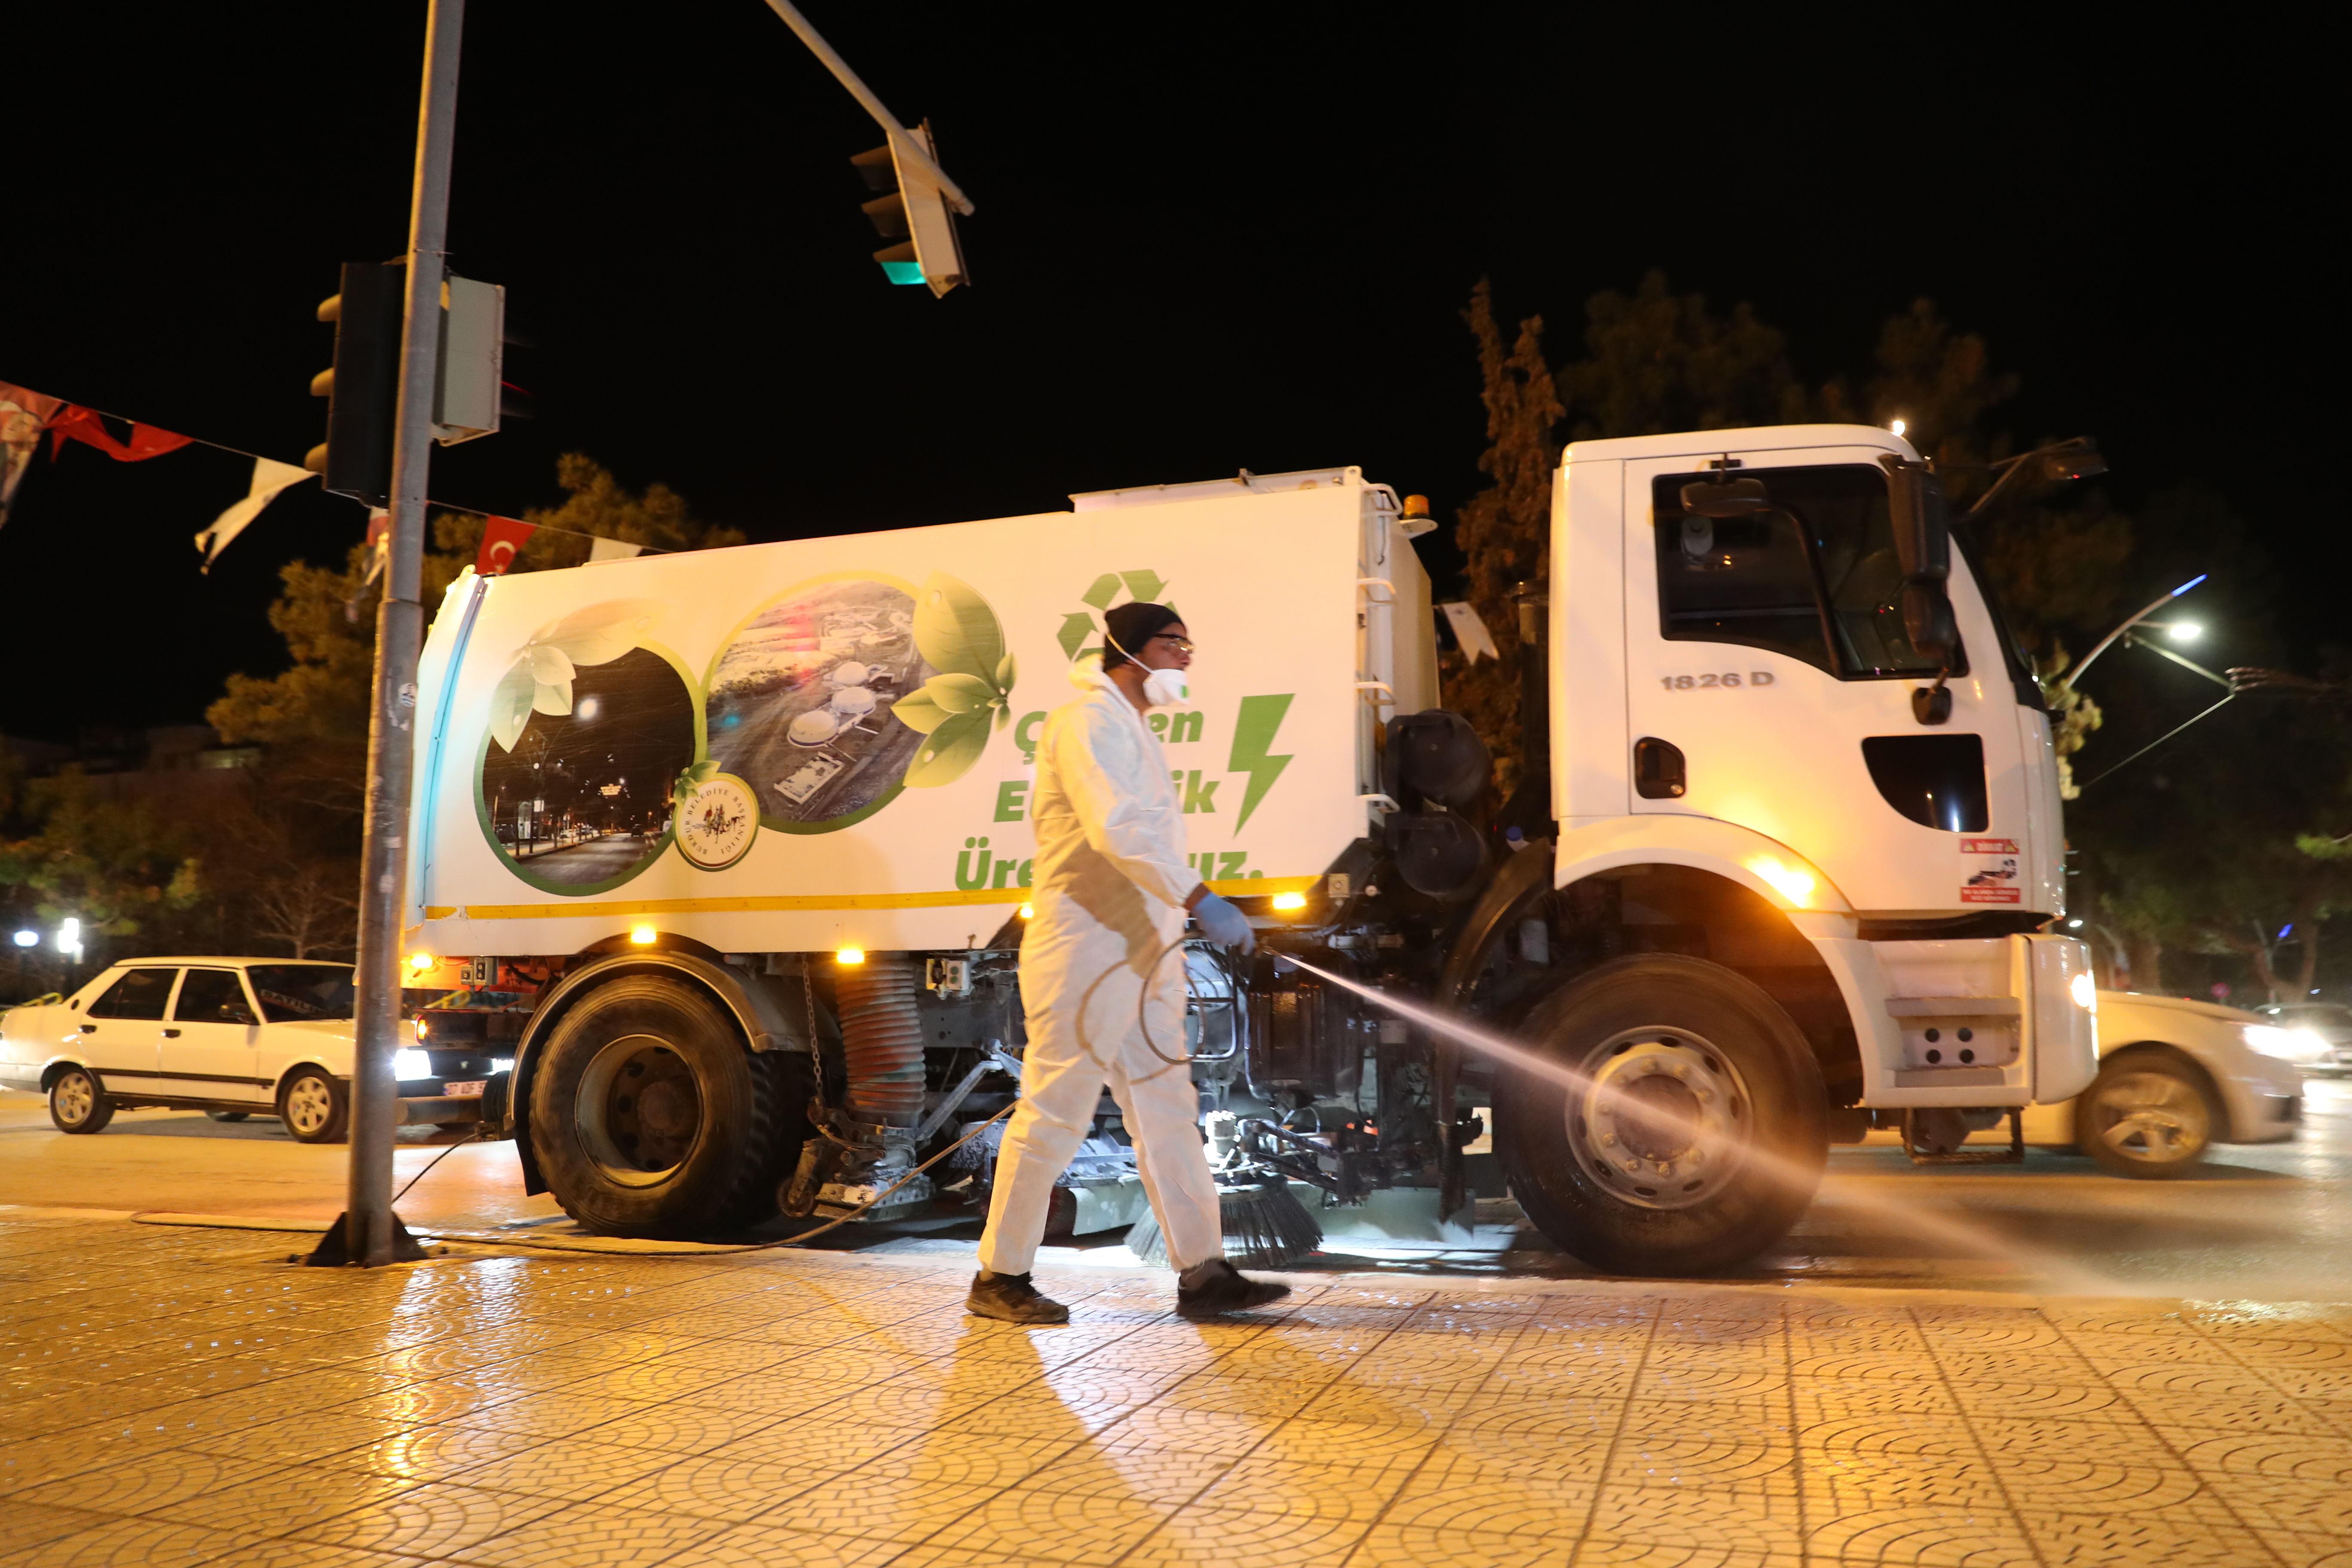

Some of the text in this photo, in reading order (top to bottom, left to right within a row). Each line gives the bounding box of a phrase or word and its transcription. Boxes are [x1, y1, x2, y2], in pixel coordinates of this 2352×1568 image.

[1660, 671, 1774, 690] 1826 D
[686, 821, 707, 854] BURDUR
